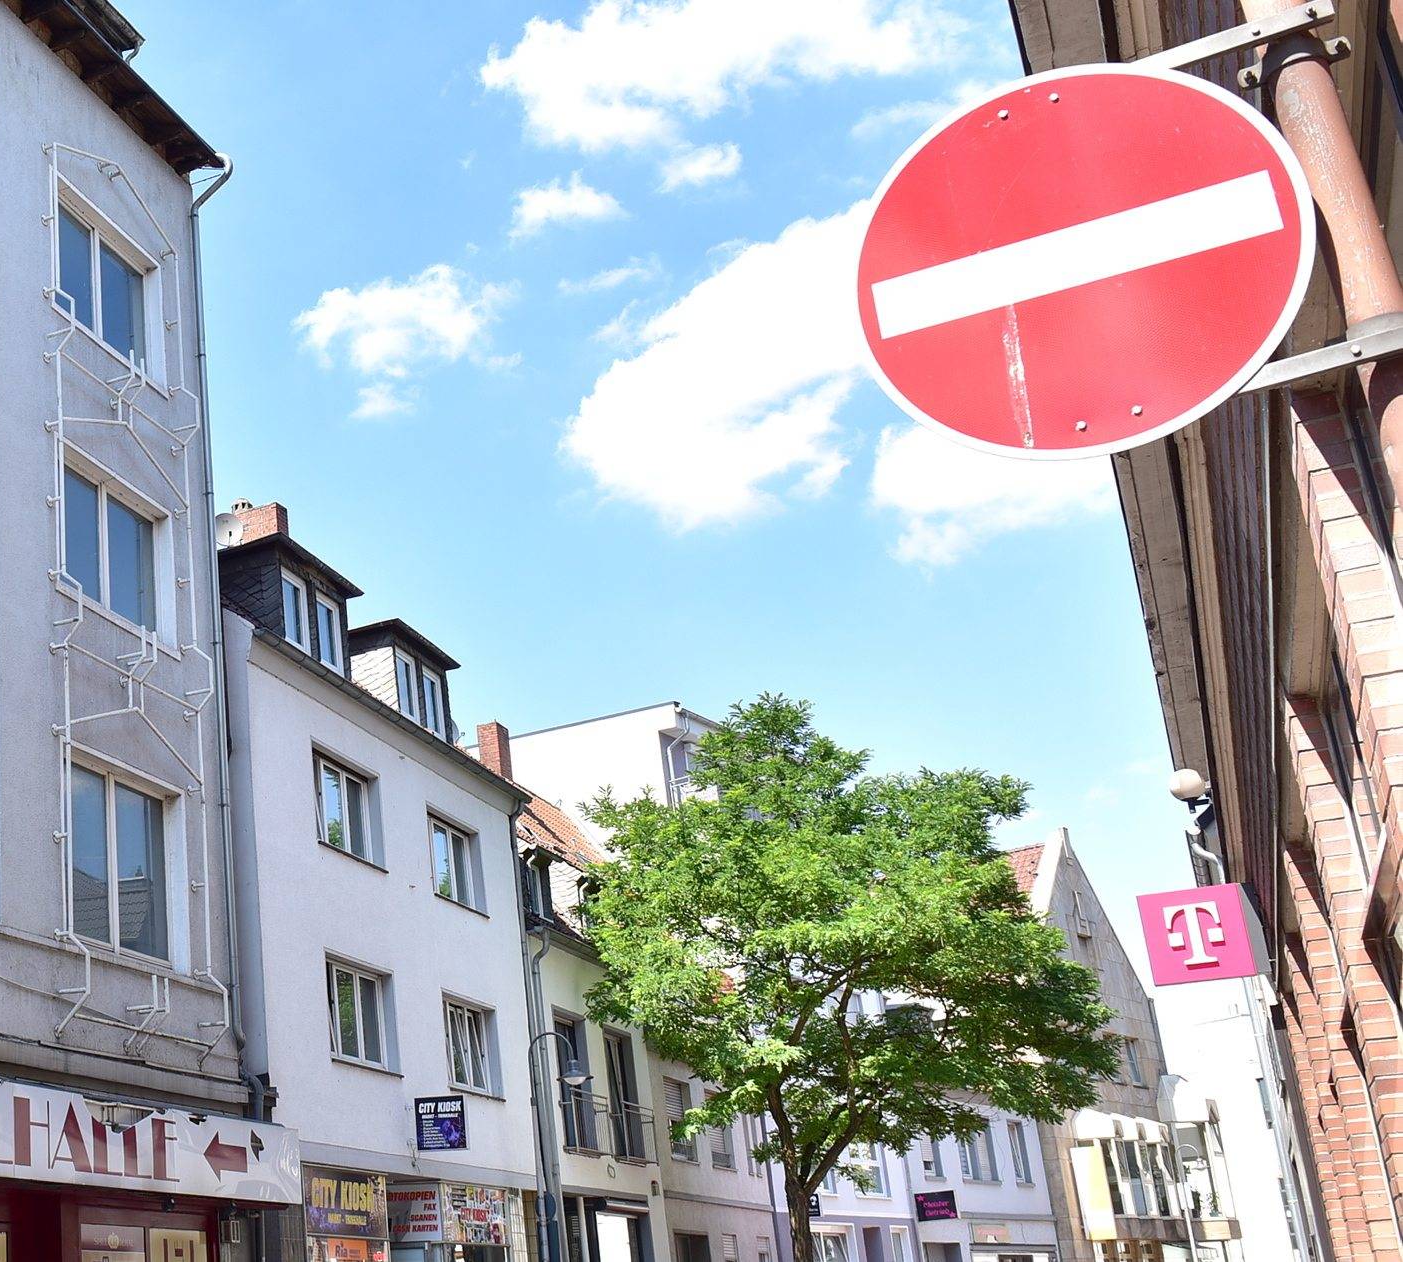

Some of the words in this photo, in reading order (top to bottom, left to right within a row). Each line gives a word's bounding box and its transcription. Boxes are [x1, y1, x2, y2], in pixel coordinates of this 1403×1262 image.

[1162, 900, 1221, 967] T
[418, 1102, 436, 1114] CITY
[437, 1100, 462, 1113] KIOSK
[311, 1176, 338, 1209] CITY
[340, 1180, 375, 1212] KIOSK
[387, 1190, 437, 1201] OTOKOPIEN
[423, 1203, 437, 1211] FAX
[412, 1224, 439, 1232] KARTEN
